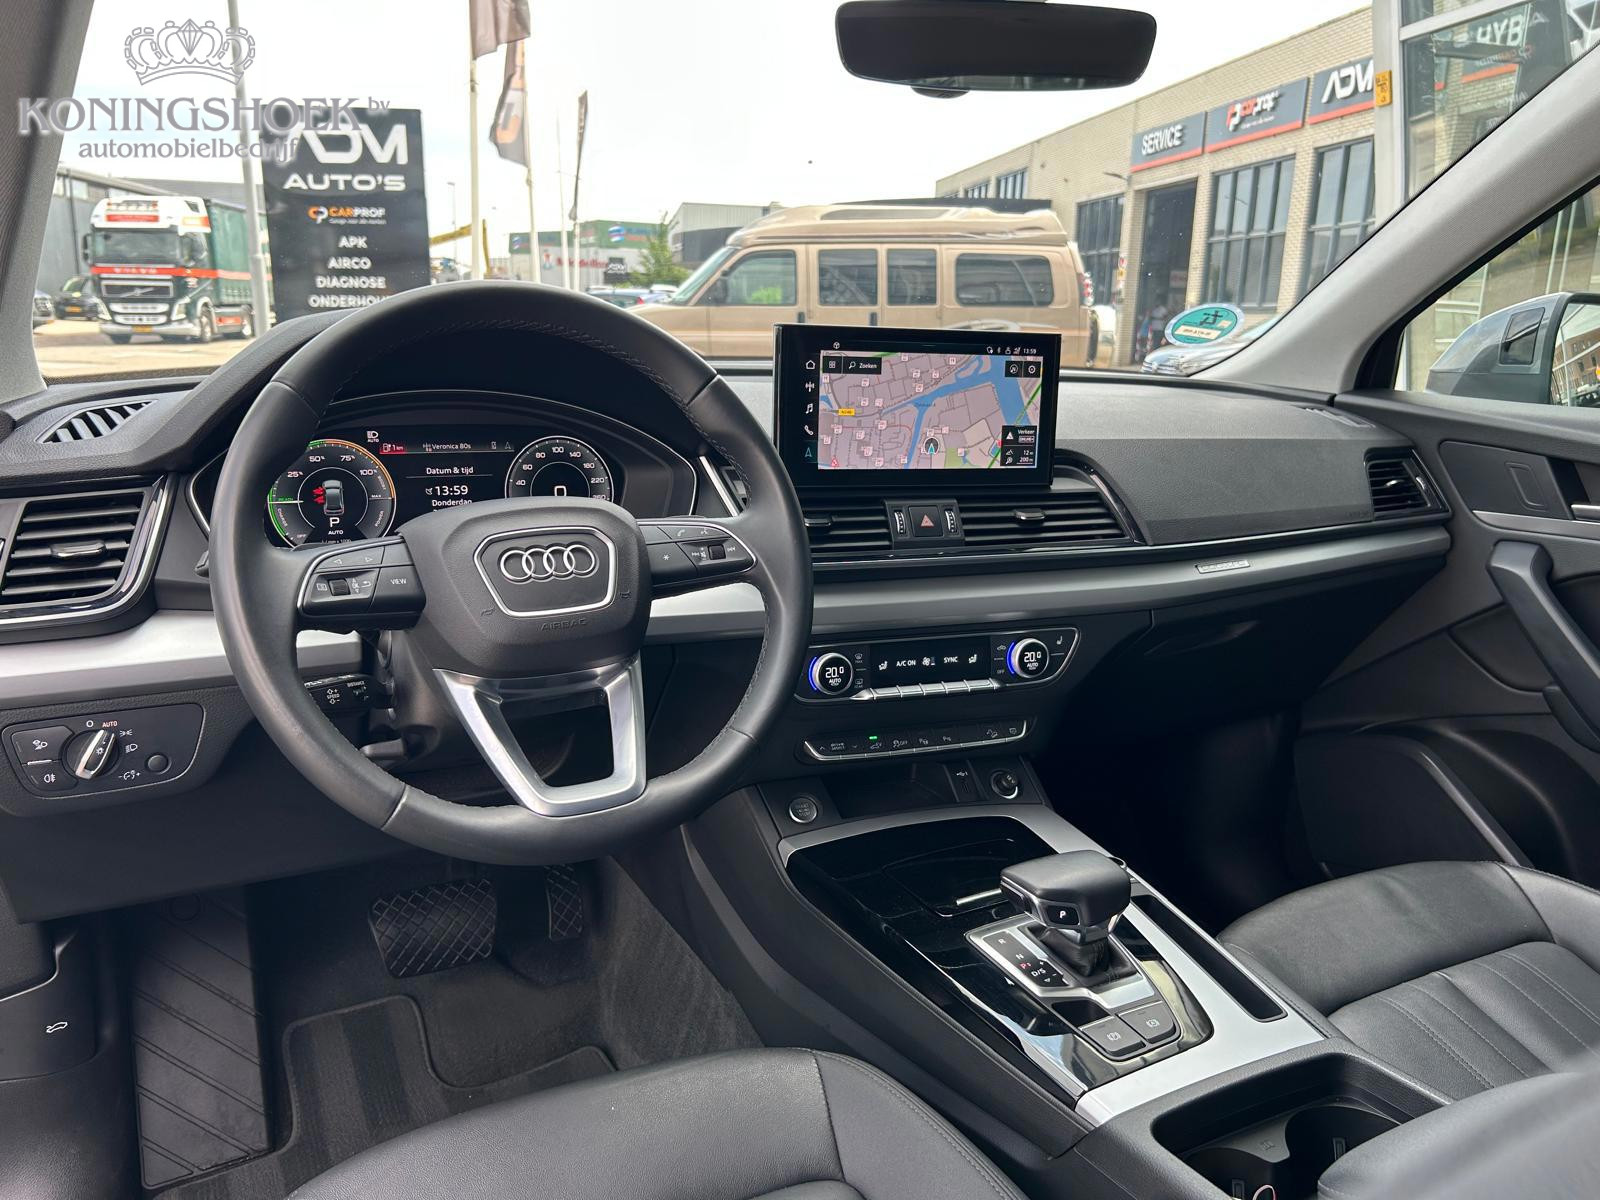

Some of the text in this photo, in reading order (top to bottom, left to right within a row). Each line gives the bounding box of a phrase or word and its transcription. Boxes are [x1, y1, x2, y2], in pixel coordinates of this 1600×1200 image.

[1141, 123, 1184, 156] SERVICE
[283, 173, 406, 191] AUTO'S
[329, 206, 386, 218] CARPROF
[338, 236, 368, 249] APK
[327, 256, 373, 270] AIRCO
[315, 275, 387, 289] DIAGNOSE
[459, 442, 472, 450] 80s
[426, 467, 452, 475] Datum
[461, 466, 474, 476] tijd
[434, 485, 469, 496] 13:59
[329, 516, 340, 528] P
[943, 656, 959, 664] SYNC
[102, 720, 118, 728] AUTO
[1059, 910, 1067, 919] P
